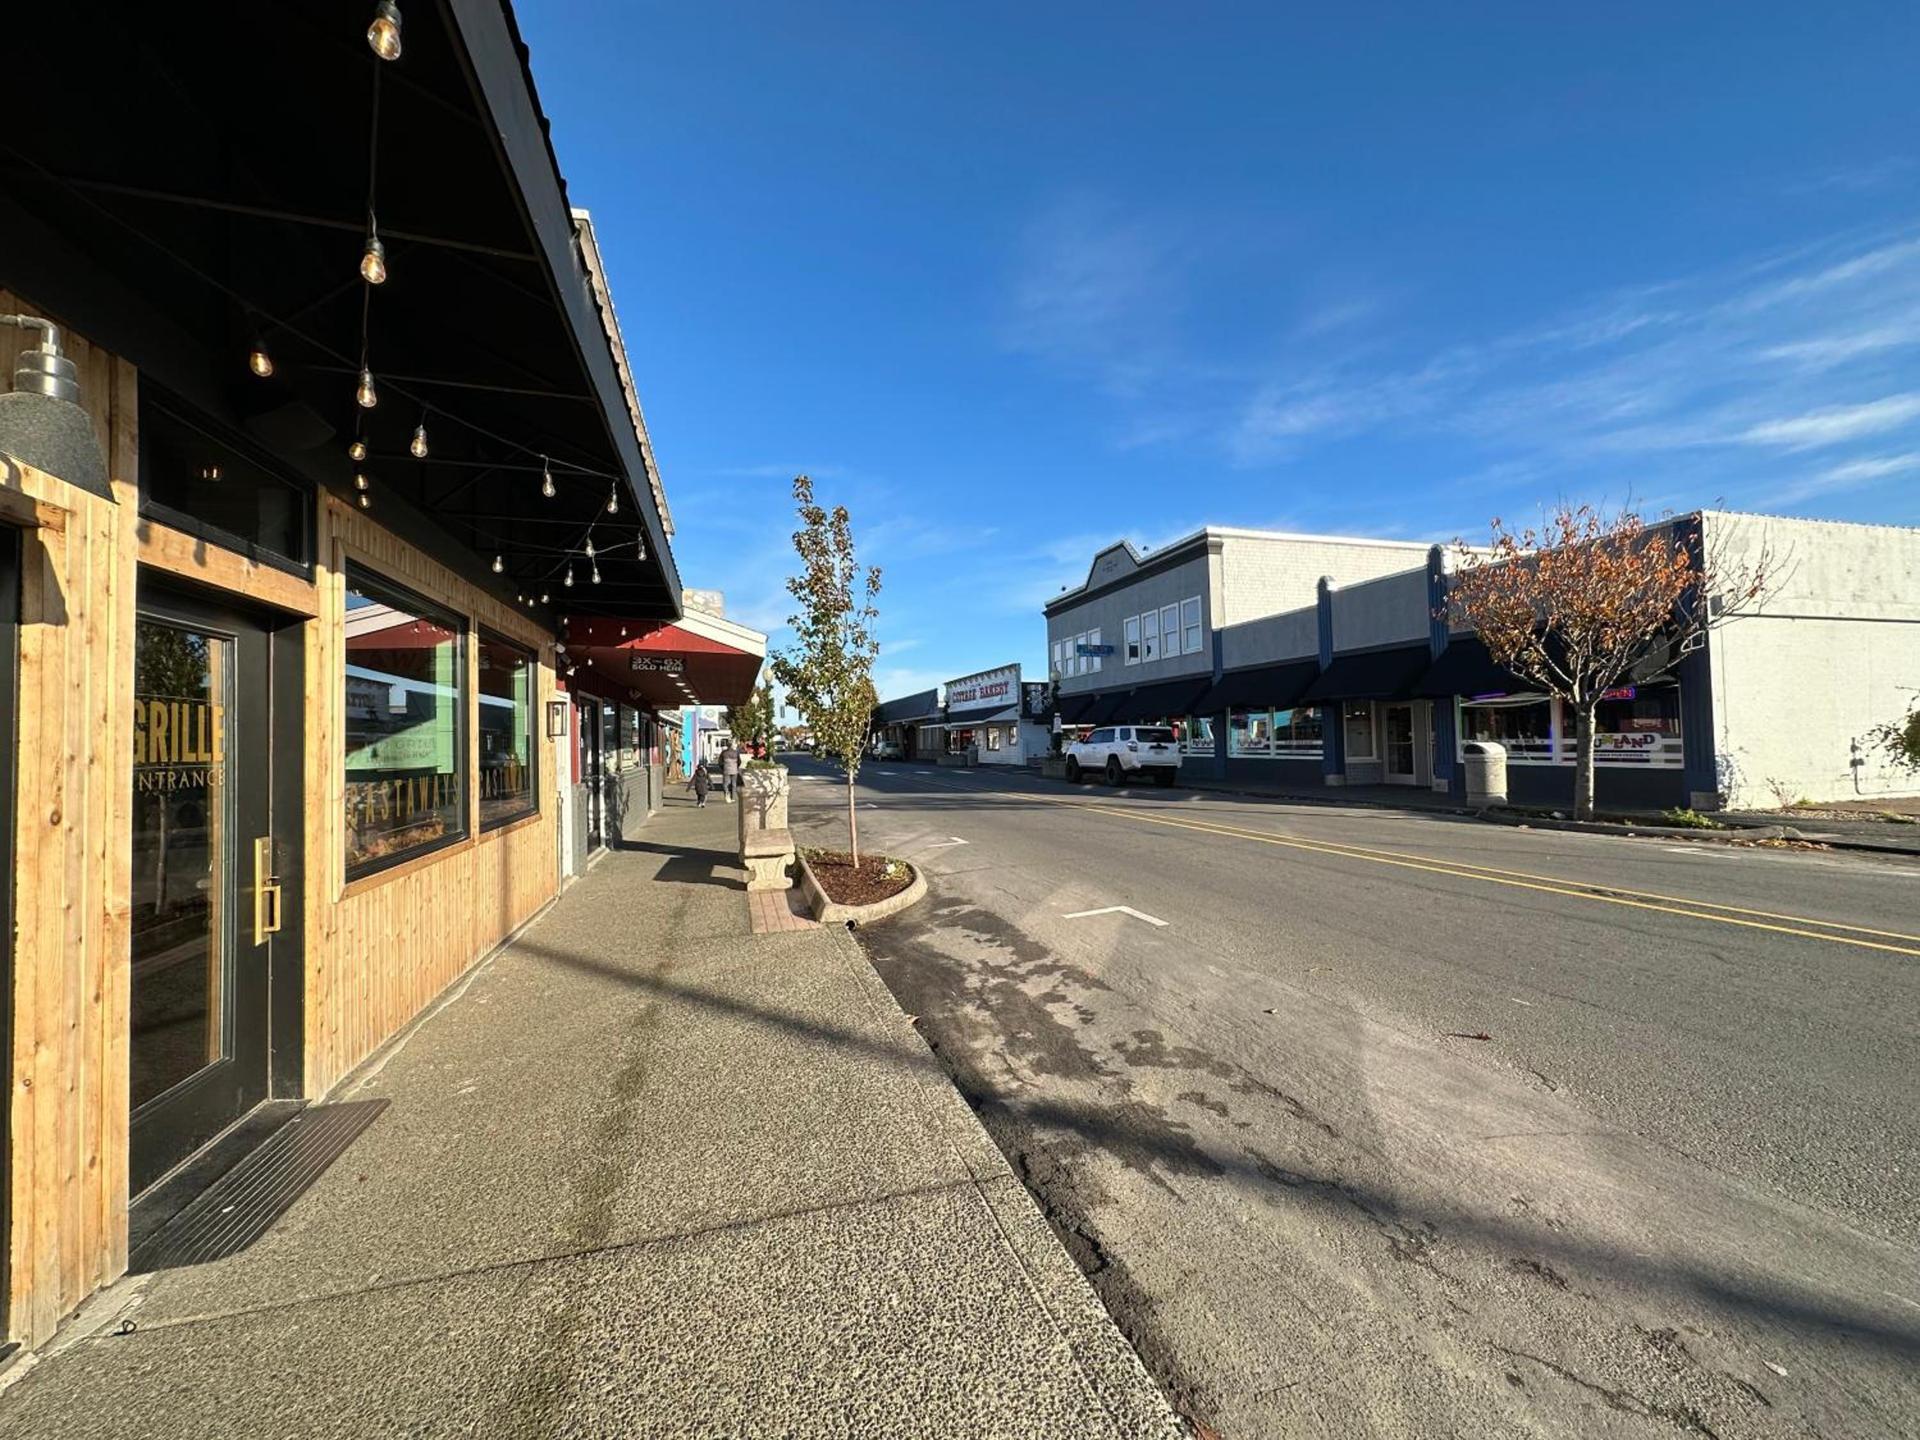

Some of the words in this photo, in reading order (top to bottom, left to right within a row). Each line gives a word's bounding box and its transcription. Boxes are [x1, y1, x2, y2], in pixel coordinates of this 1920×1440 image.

[133, 699, 224, 765] GRILLE
[1594, 733, 1656, 749] UNLAND
[136, 768, 226, 791] NTRANCE
